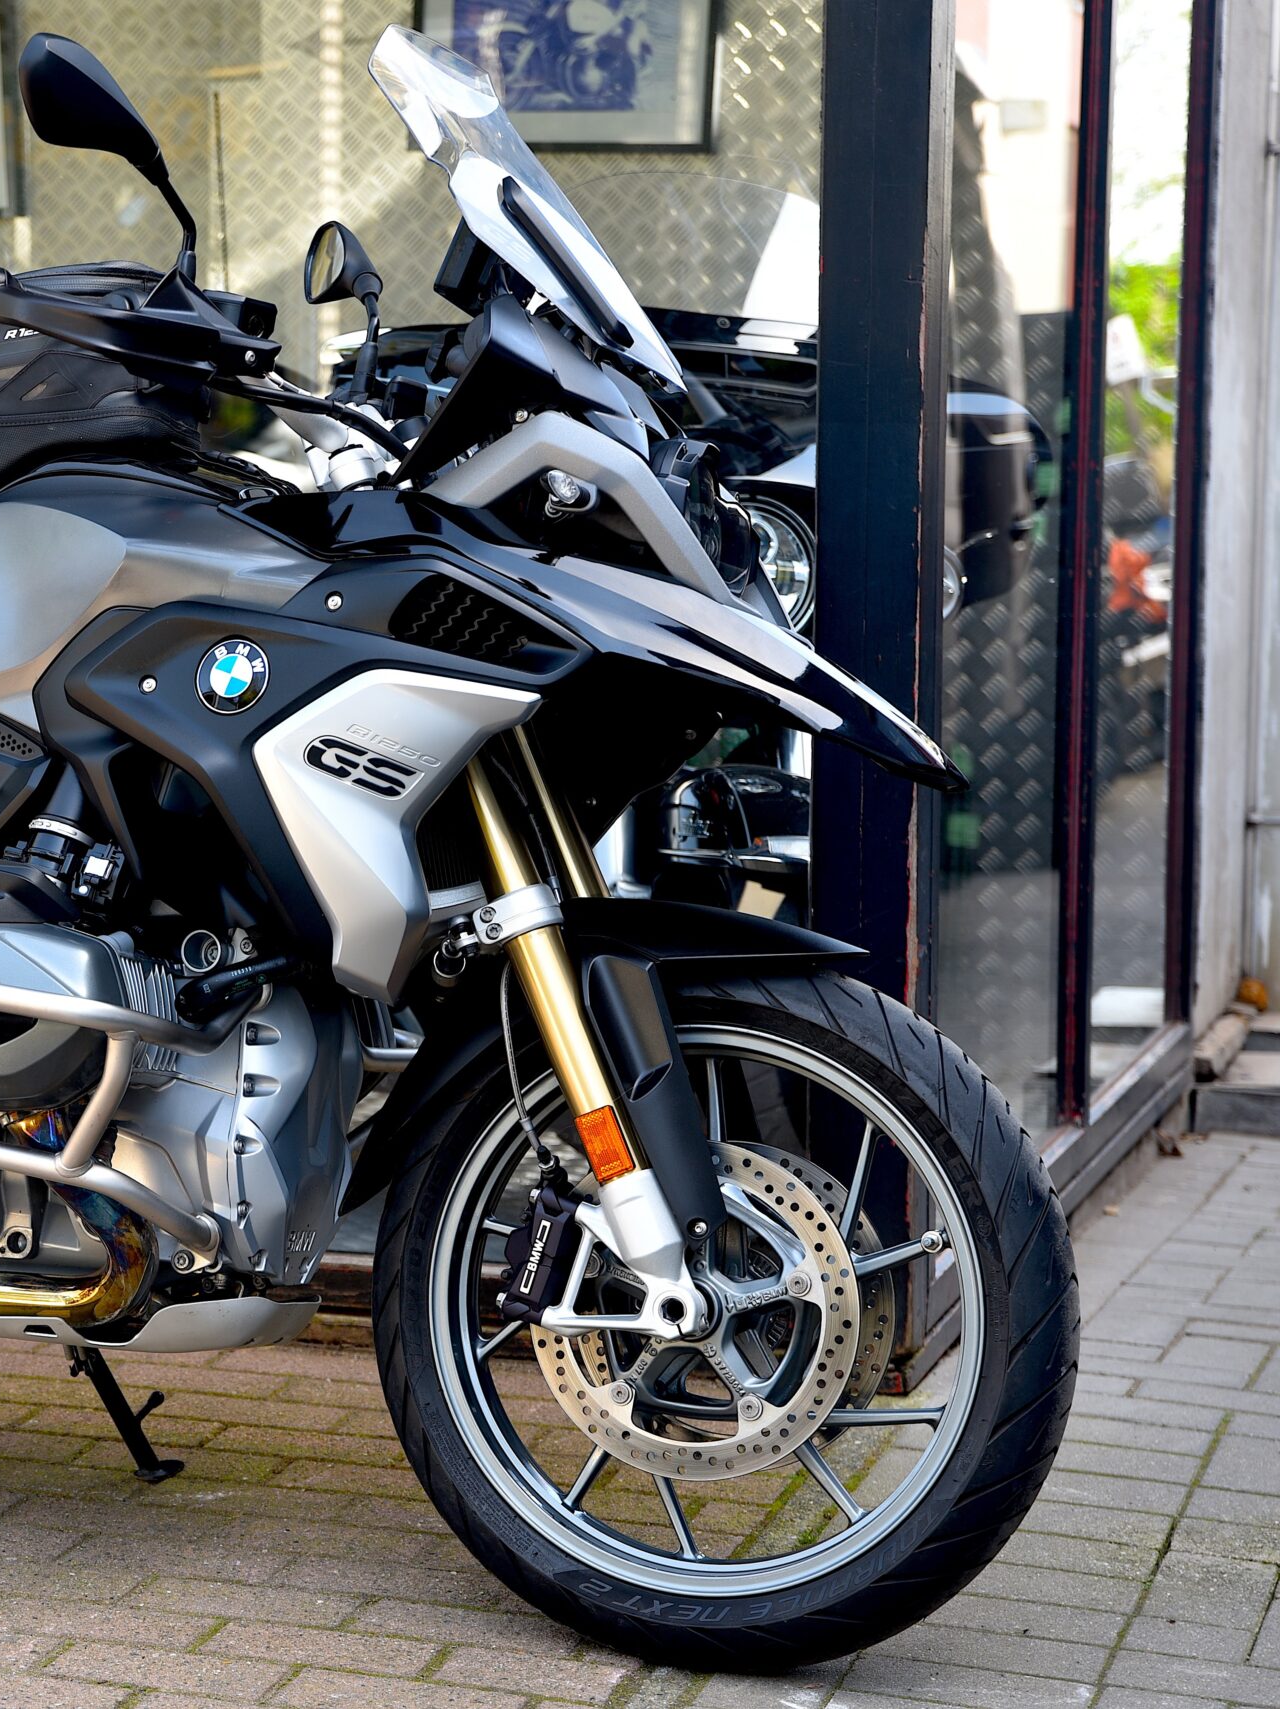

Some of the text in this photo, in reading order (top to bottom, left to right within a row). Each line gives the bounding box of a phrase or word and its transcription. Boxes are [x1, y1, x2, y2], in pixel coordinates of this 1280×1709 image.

[214, 643, 265, 673] BMW
[307, 739, 418, 797] GS
[287, 1230, 317, 1252] BMW
[526, 1238, 545, 1272] BMW
[747, 1508, 940, 1620] TOURANCE
[581, 1577, 608, 1595] 2
